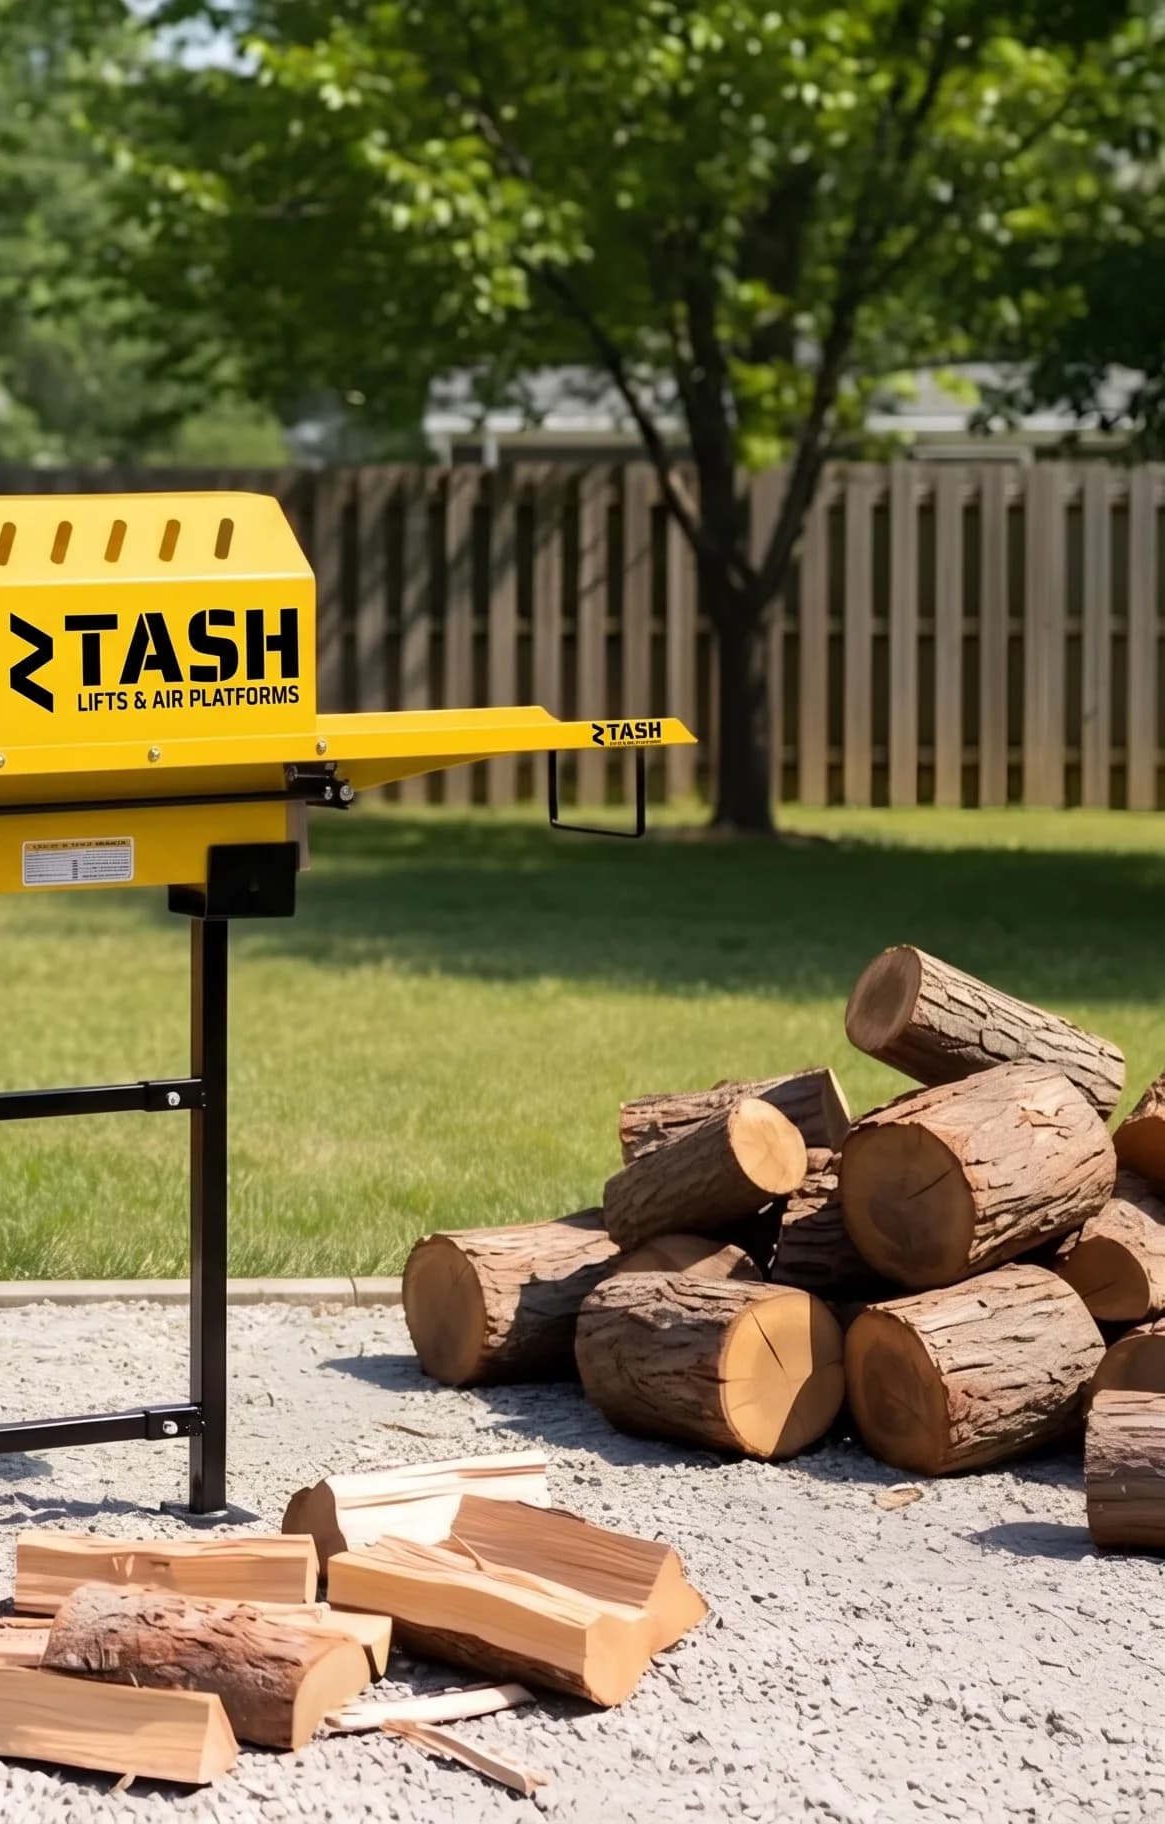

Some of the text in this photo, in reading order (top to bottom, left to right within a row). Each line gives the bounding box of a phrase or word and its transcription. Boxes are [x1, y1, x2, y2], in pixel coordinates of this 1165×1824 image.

[65, 608, 299, 686] TASH
[78, 685, 299, 712] LIFTS & AIR PLATFORMS
[607, 721, 661, 740] TASH
